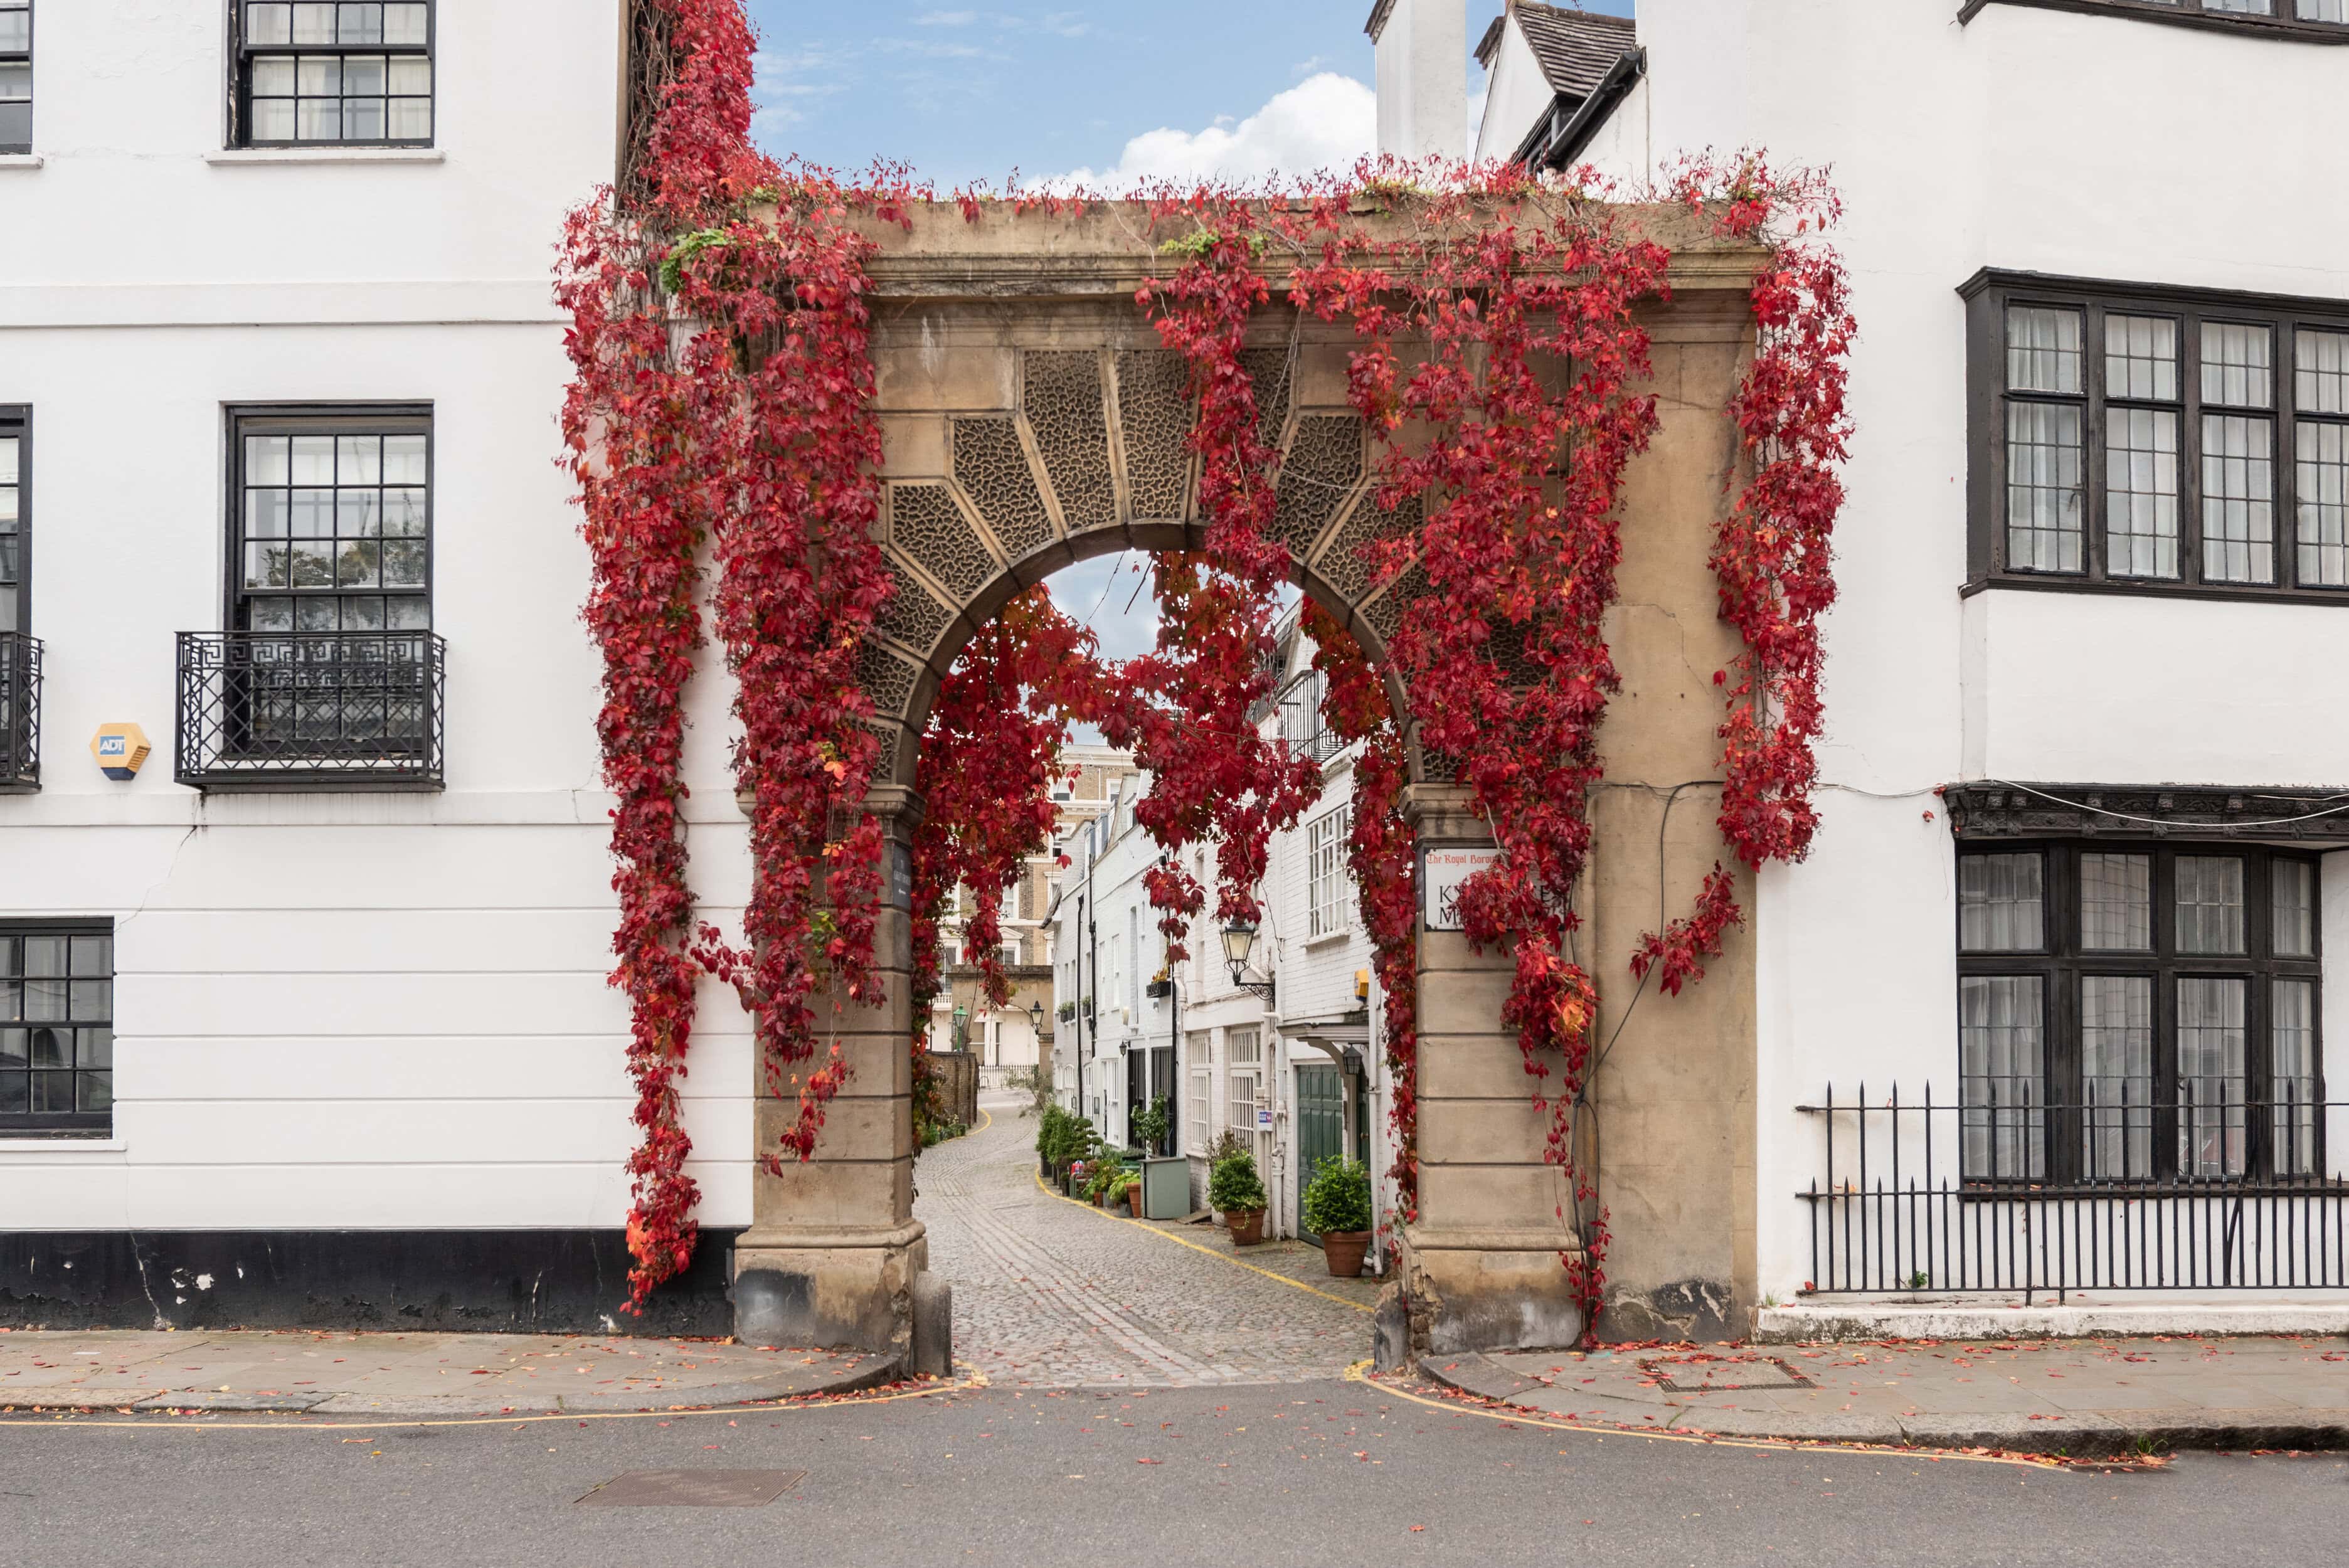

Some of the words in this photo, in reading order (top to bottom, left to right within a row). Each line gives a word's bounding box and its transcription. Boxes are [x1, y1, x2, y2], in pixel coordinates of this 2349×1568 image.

[100, 739, 125, 751] ADT
[1426, 854, 1441, 864] The
[1444, 854, 1466, 866] Royal
[1470, 854, 1496, 864] Borou
